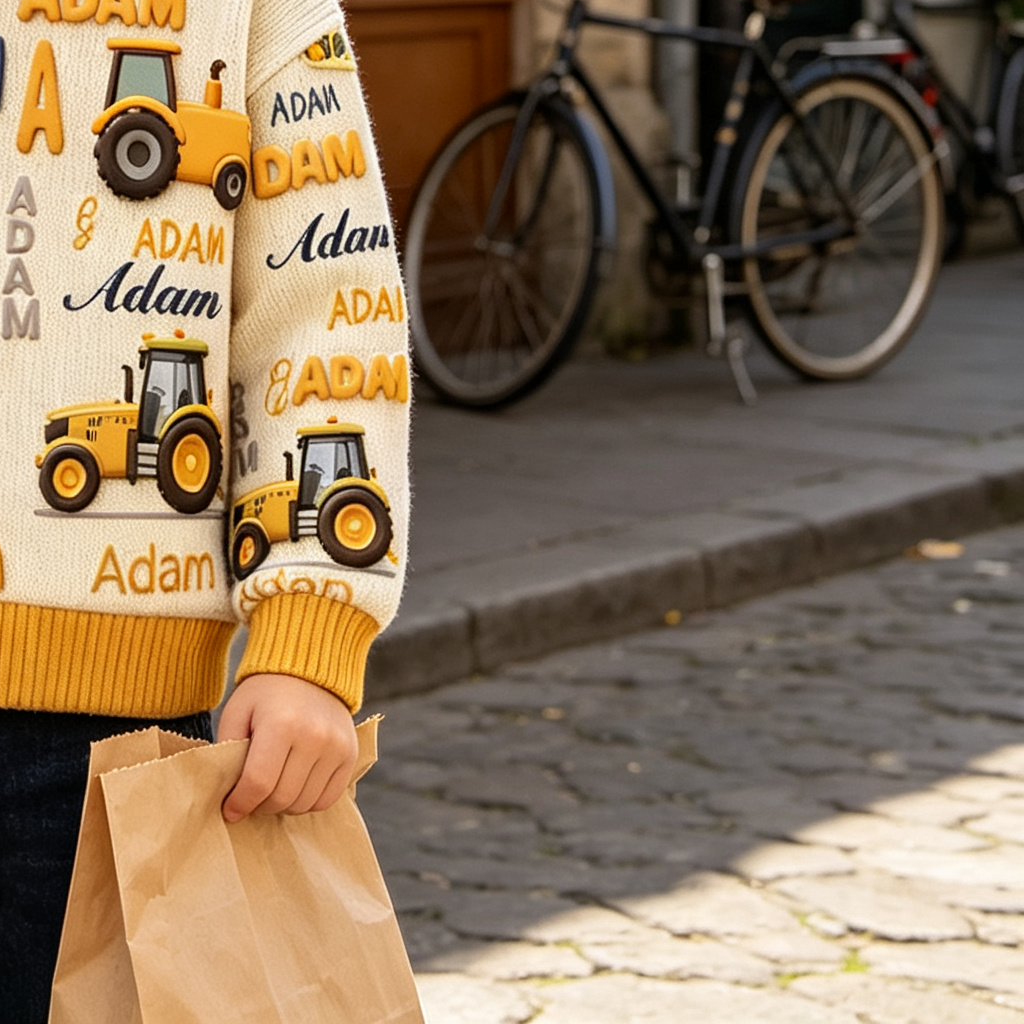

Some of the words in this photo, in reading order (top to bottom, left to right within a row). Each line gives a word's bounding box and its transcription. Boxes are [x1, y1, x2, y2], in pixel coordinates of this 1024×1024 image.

[15, 38, 65, 155] A
[1, 175, 41, 341] ADAM
[131, 216, 226, 266] ADAM
[63, 261, 223, 320] Adam
[90, 543, 216, 595] Adam
